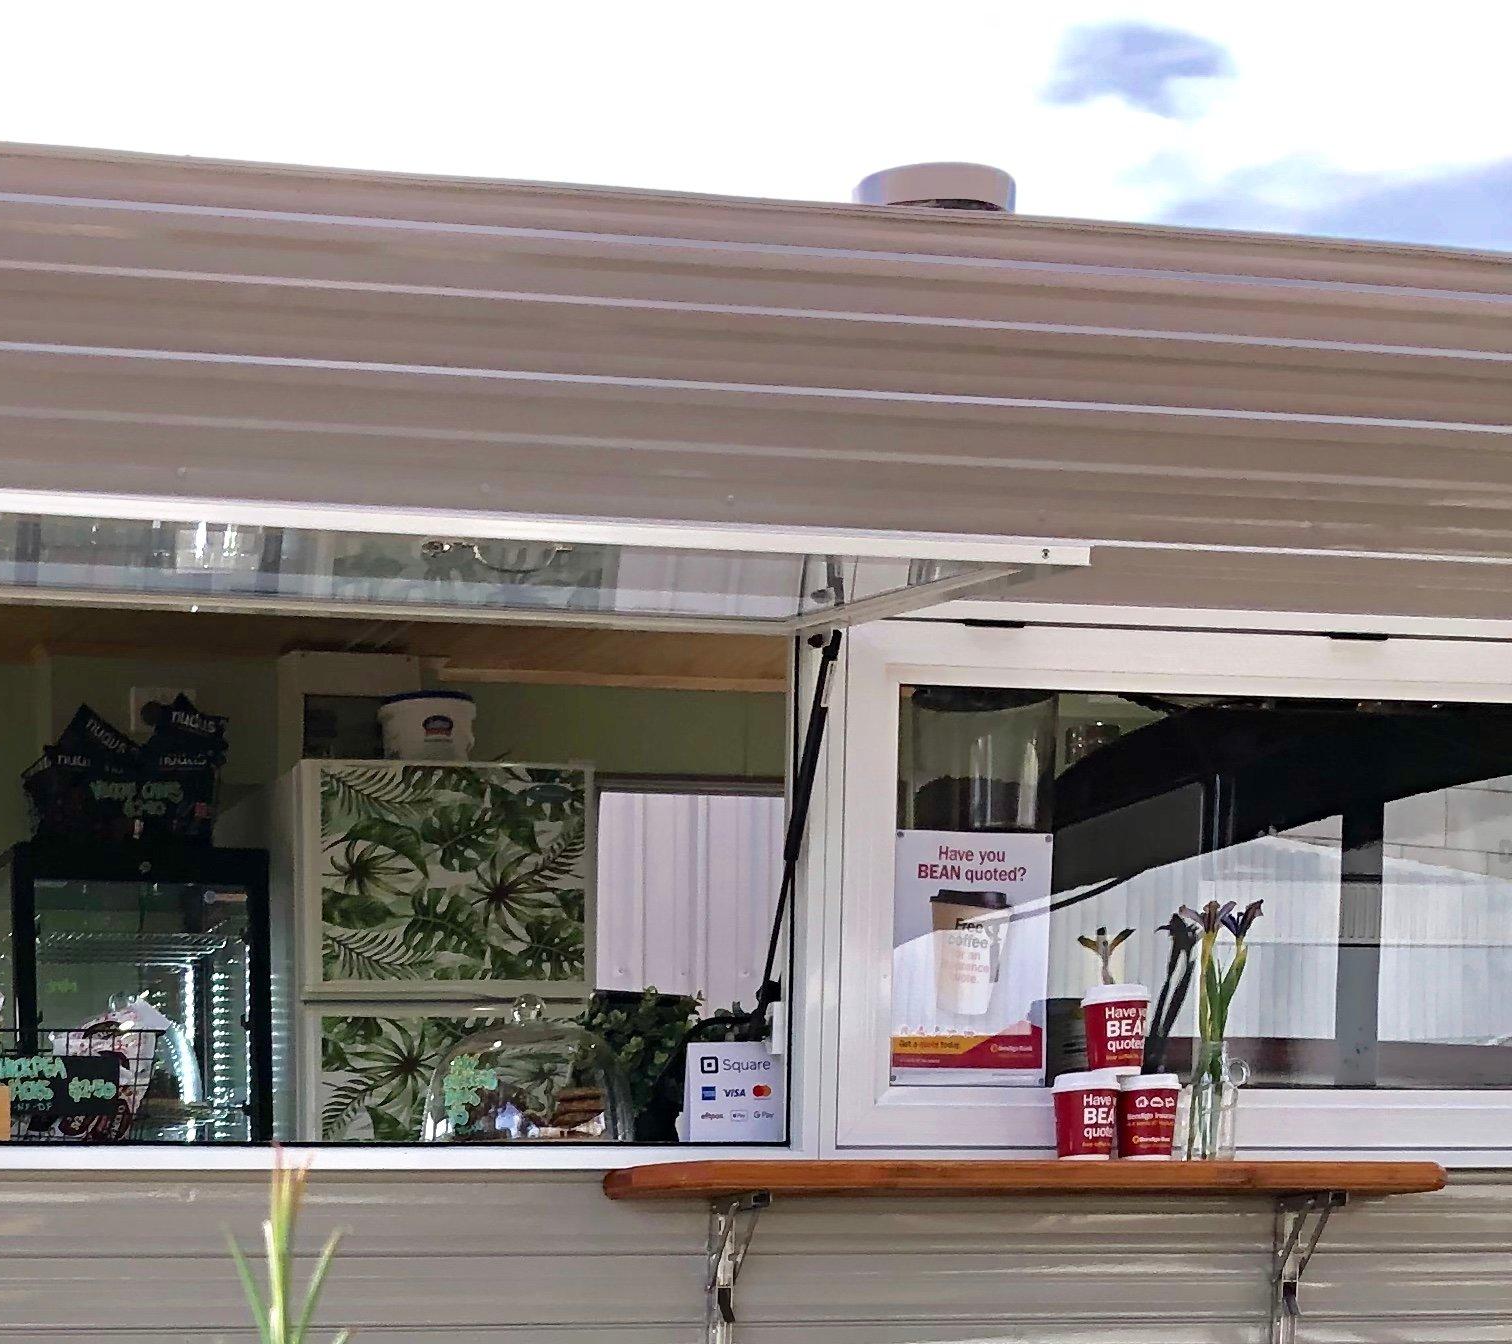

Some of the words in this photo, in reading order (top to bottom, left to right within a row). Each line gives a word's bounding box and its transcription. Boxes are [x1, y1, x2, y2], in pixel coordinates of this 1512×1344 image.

[938, 845, 974, 862] Have
[979, 850, 1006, 866] you
[918, 863, 961, 881] BEAN
[964, 866, 1027, 884] quoted?
[954, 917, 984, 934] Free
[947, 934, 989, 950] coffee
[1105, 1006, 1136, 1020] Have
[1106, 1019, 1145, 1038] BEA
[722, 1058, 771, 1073] Square
[723, 1088, 746, 1097] VISA
[1083, 1093, 1111, 1107] Have
[1083, 1107, 1114, 1125] BEA
